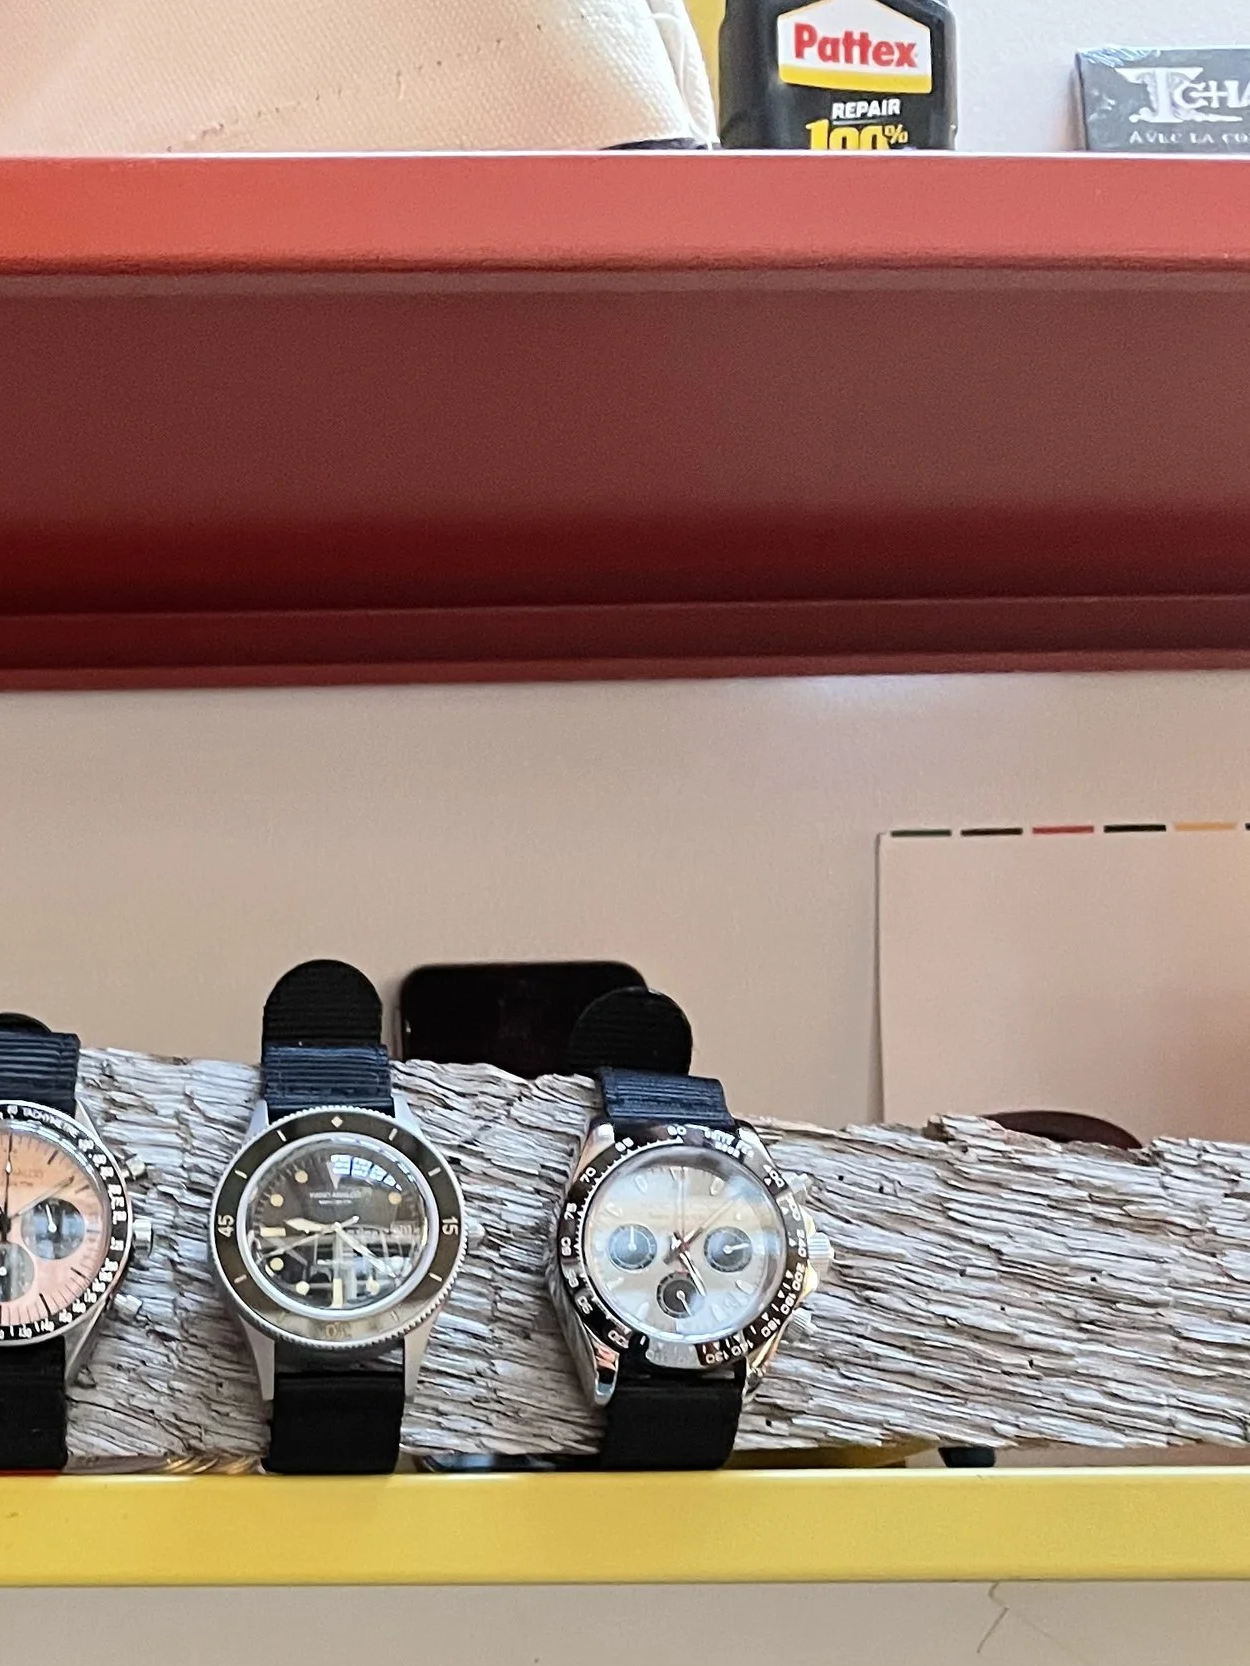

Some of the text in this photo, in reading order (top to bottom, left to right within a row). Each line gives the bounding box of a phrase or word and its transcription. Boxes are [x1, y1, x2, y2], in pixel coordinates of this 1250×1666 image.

[793, 22, 919, 69] Pattex
[831, 98, 901, 120] REPAIR
[579, 1166, 597, 1183] 70
[217, 1214, 235, 1238] 45
[442, 1216, 459, 1236] 15
